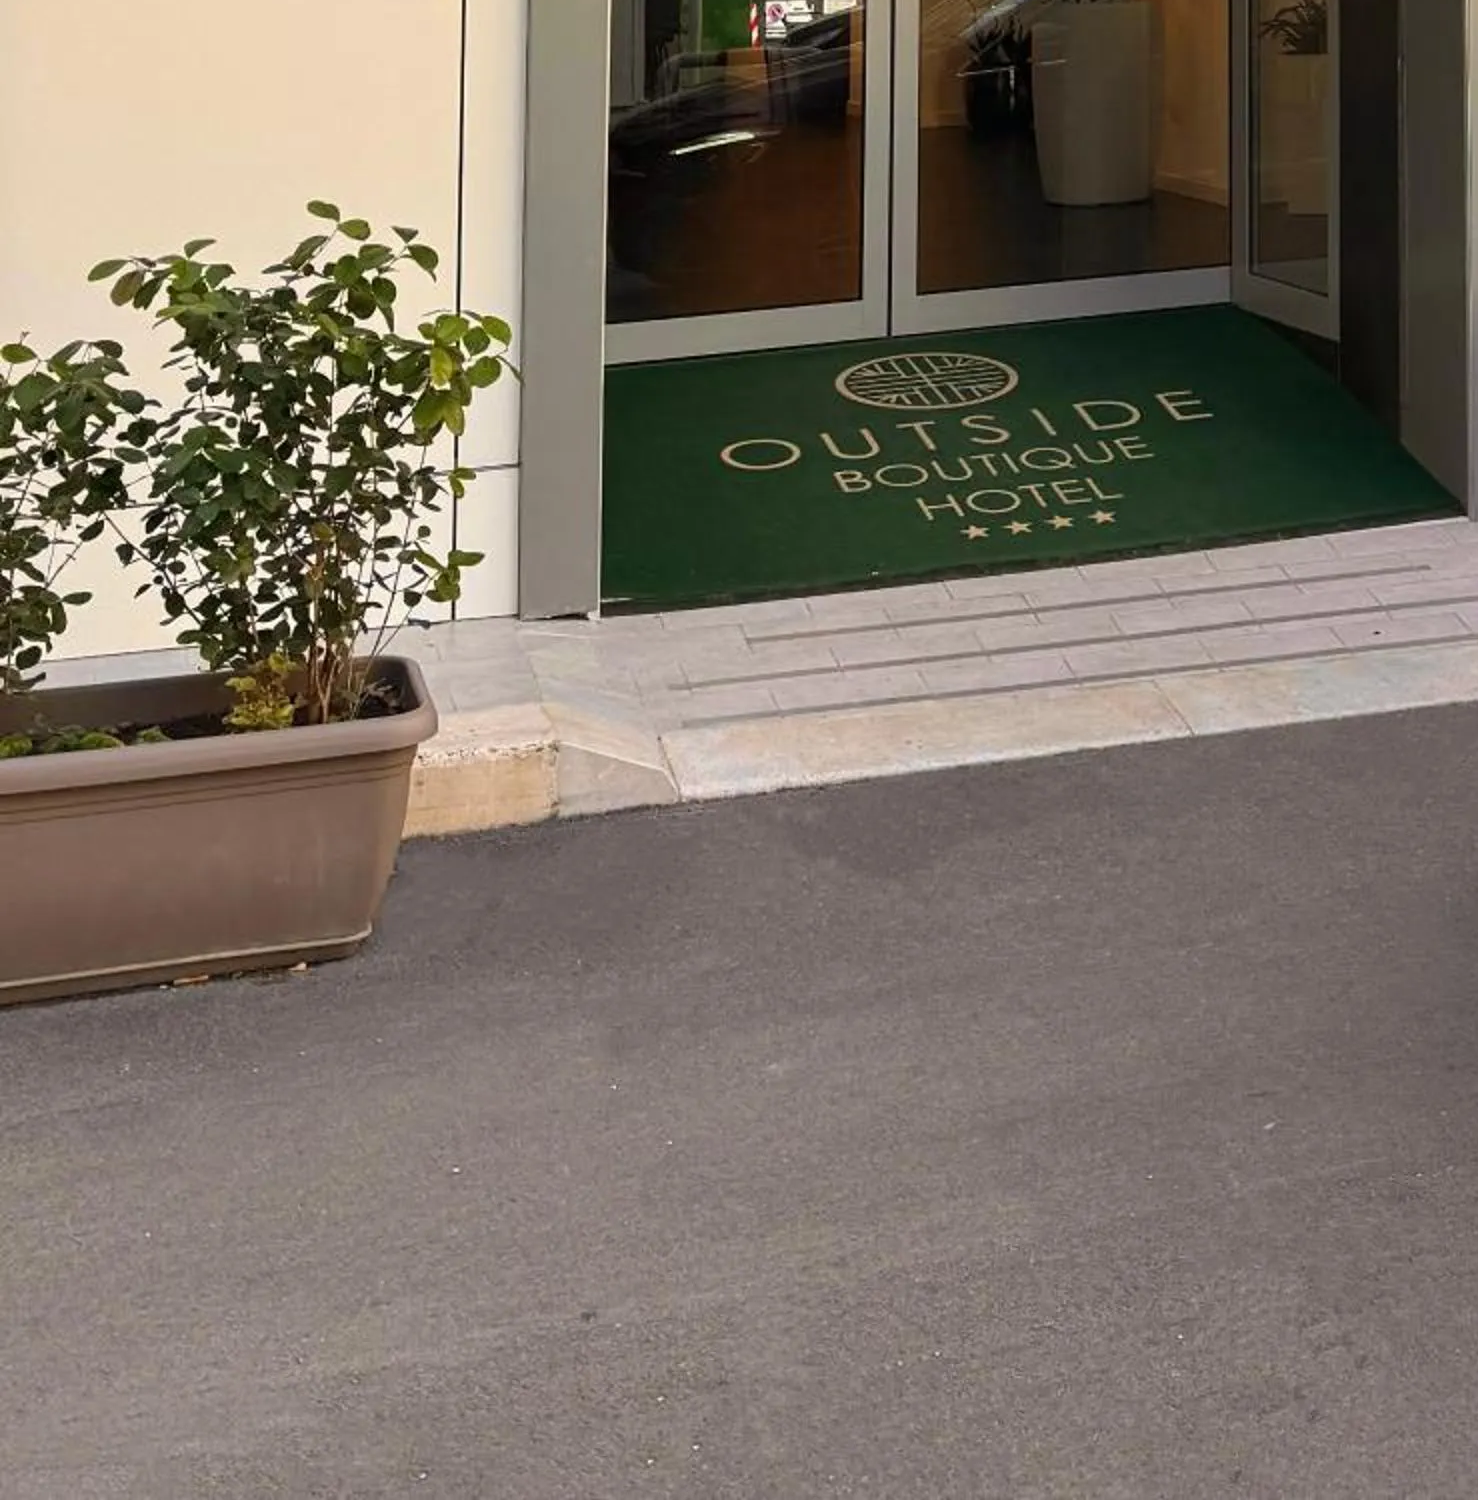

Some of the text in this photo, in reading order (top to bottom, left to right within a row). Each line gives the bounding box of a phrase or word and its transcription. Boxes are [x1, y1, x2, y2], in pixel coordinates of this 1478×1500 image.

[720, 389, 1215, 470] OUTSIDE
[832, 435, 1155, 494] BOUTIQUE
[915, 476, 1124, 521] HOTEL
